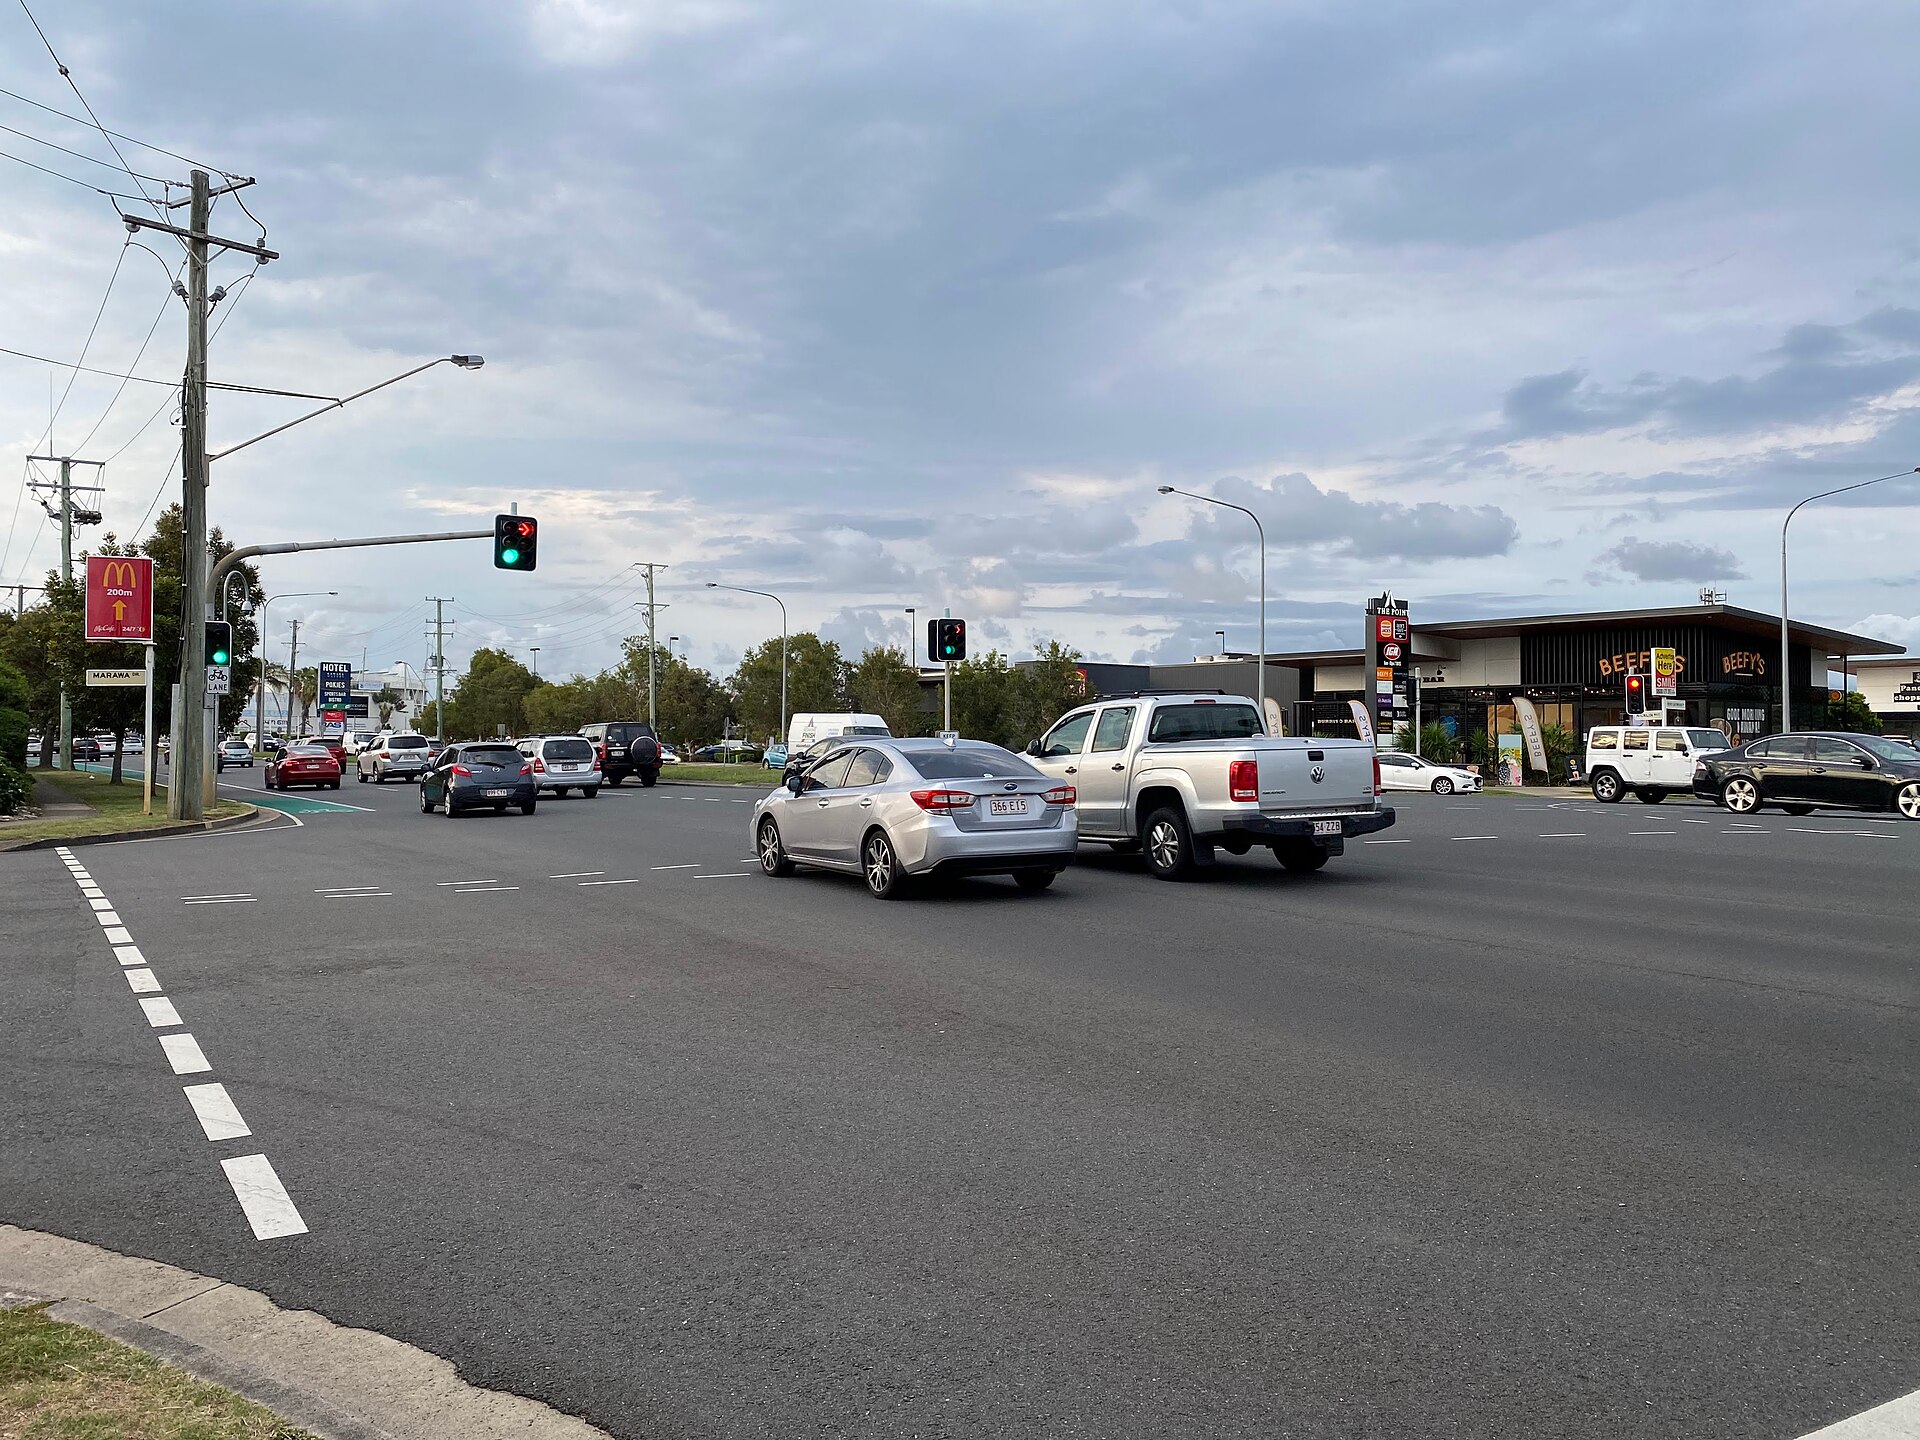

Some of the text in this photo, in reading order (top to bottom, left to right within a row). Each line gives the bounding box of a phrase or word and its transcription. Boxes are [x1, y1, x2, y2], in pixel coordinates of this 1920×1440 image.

[1386, 646, 1398, 656] IGA
[322, 663, 348, 672] HOTEL
[1599, 651, 1686, 676] BEEFS
[1722, 652, 1765, 674] BEEFY'S
[1656, 678, 1675, 688] SMILE
[992, 802, 1007, 812] 366
[1313, 822, 1324, 832] 54
